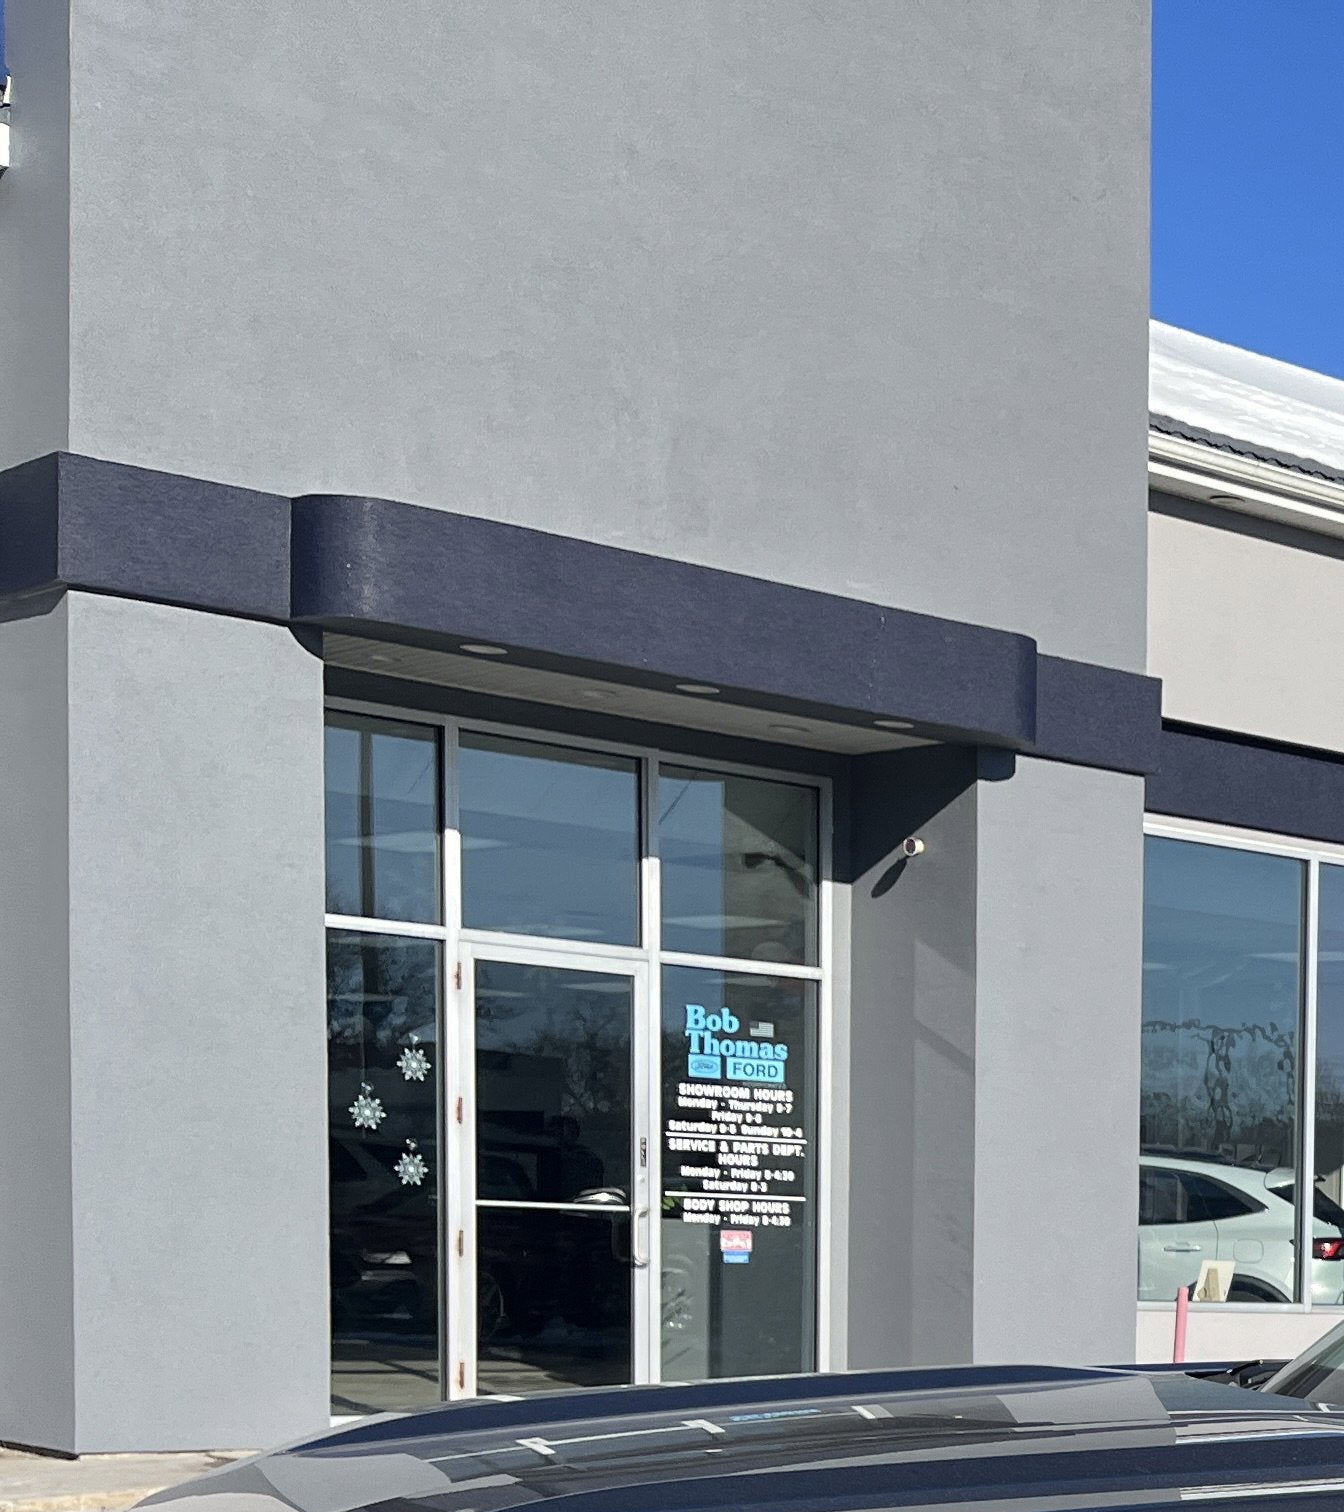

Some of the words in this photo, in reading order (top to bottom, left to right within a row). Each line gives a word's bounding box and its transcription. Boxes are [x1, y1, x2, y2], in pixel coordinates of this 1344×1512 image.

[685, 1004, 740, 1033] Bob
[685, 1029, 788, 1061] Thomas
[732, 1062, 778, 1078] FORD
[679, 1083, 750, 1099] SHOWROOM
[754, 1089, 793, 1102] HOURS
[678, 1097, 717, 1109] Monday
[729, 1100, 773, 1114] Thursday
[712, 1111, 742, 1123] Friday
[669, 1120, 717, 1133] Saturday
[741, 1125, 778, 1137] Sunday
[669, 1138, 715, 1151] SERVICE
[720, 1141, 728, 1152] &
[733, 1142, 769, 1154] PARTS
[773, 1144, 805, 1157] DEPT.
[719, 1154, 758, 1166] HOURS
[681, 1166, 720, 1178] Monday
[731, 1168, 761, 1180] Friday
[703, 1180, 747, 1192] Saturday
[684, 1198, 714, 1210] BODY
[719, 1200, 749, 1211] SHOP
[753, 1202, 789, 1214] HOURS
[683, 1212, 720, 1225] Monday
[731, 1214, 759, 1226] Friday
